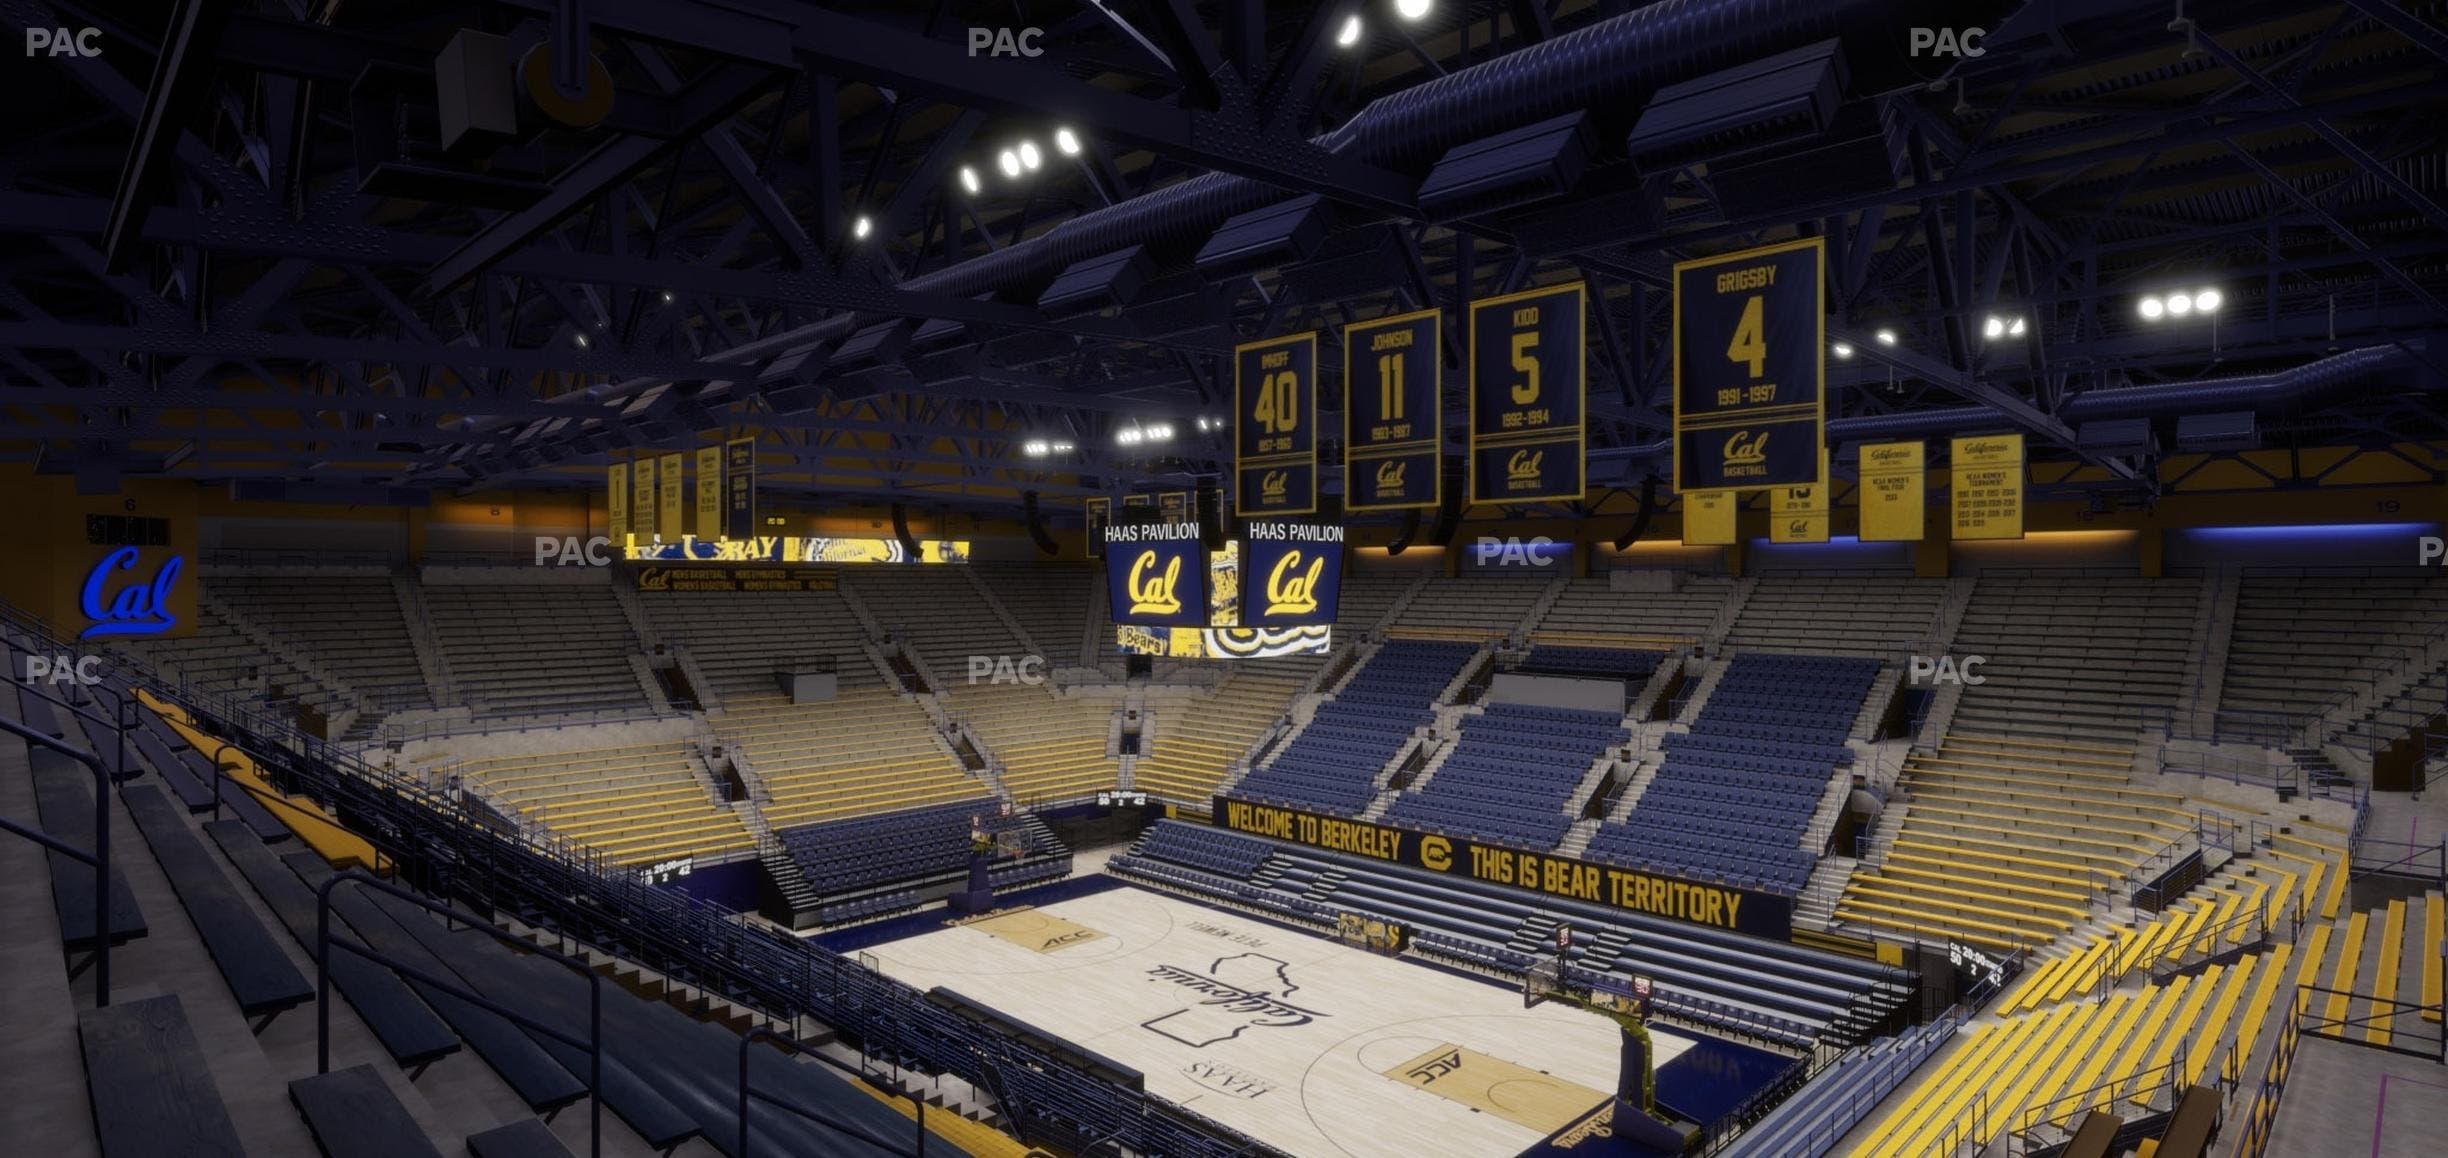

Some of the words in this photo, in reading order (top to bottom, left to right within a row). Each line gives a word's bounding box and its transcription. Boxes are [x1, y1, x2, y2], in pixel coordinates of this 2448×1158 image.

[1716, 264, 1777, 294] GRIGSBY
[1513, 306, 1540, 328] KIDD
[1371, 330, 1412, 352] JOHNSON
[1726, 295, 1766, 379] 4
[1511, 331, 1540, 405] 5
[1378, 352, 1405, 421] 11
[1717, 384, 1777, 406] 1991-1997
[1253, 370, 1298, 434] 40
[1722, 430, 1769, 466] Cal
[1376, 460, 1406, 488] Cal
[1507, 449, 1544, 480] Cal
[1723, 464, 1768, 478] BASKETBALL
[1262, 470, 1288, 496] Cal
[1105, 525, 1138, 542] HAAS
[1141, 522, 1199, 541] PAVILION
[1250, 522, 1286, 540] HAAS
[1290, 524, 1344, 542] PAVILION
[80, 545, 184, 640] Cal
[639, 567, 671, 592] Cal
[1128, 549, 1182, 615] Cal
[1263, 549, 1325, 617] Cal
[1126, 627, 1161, 654] Bears
[653, 860, 677, 875] 20:00
[678, 864, 691, 876] 42
[1227, 801, 1294, 840] WELCOME
[1297, 813, 1317, 844] TO
[1320, 817, 1402, 862] BERKELEY
[1470, 843, 1513, 884] THIS
[1518, 853, 1539, 890] IS
[1543, 858, 1601, 902] BEAR
[1608, 870, 1743, 929] TERRITORY
[1950, 951, 1962, 966] 50
[1970, 963, 1977, 976] 2
[1962, 946, 1985, 966] 20:00
[1145, 964, 1315, 1027] California
[1183, 1061, 1268, 1098] HAAS
[1410, 1053, 1461, 1085] ACC
